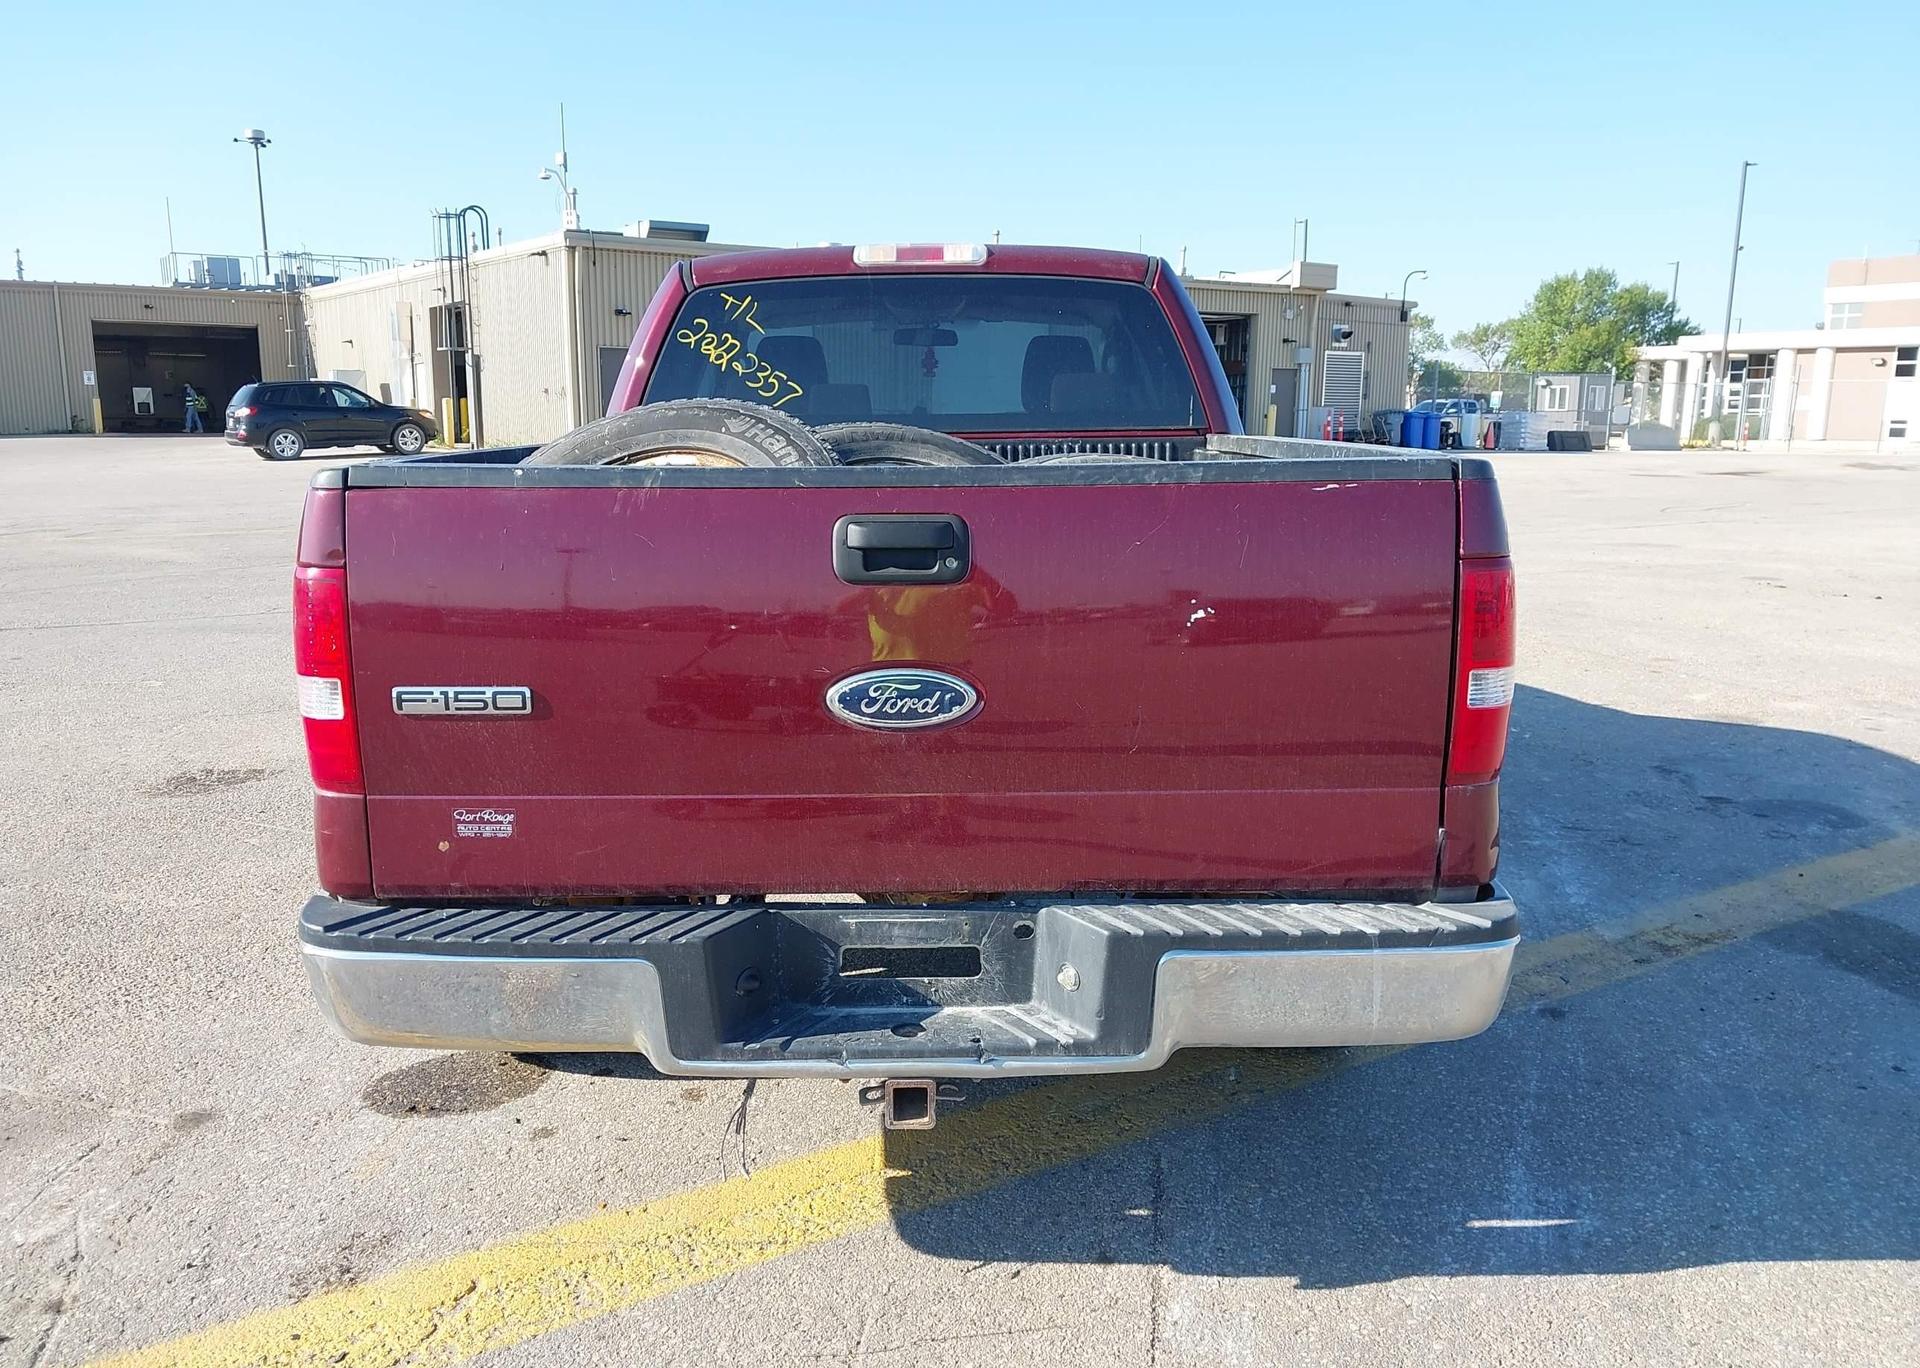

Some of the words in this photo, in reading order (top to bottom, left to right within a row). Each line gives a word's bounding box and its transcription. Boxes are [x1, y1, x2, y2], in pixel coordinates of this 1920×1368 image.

[744, 423, 806, 467] Han
[395, 690, 528, 712] F-150
[860, 683, 942, 714] Ford
[453, 809, 481, 822] Fort
[481, 809, 515, 824] Rouge
